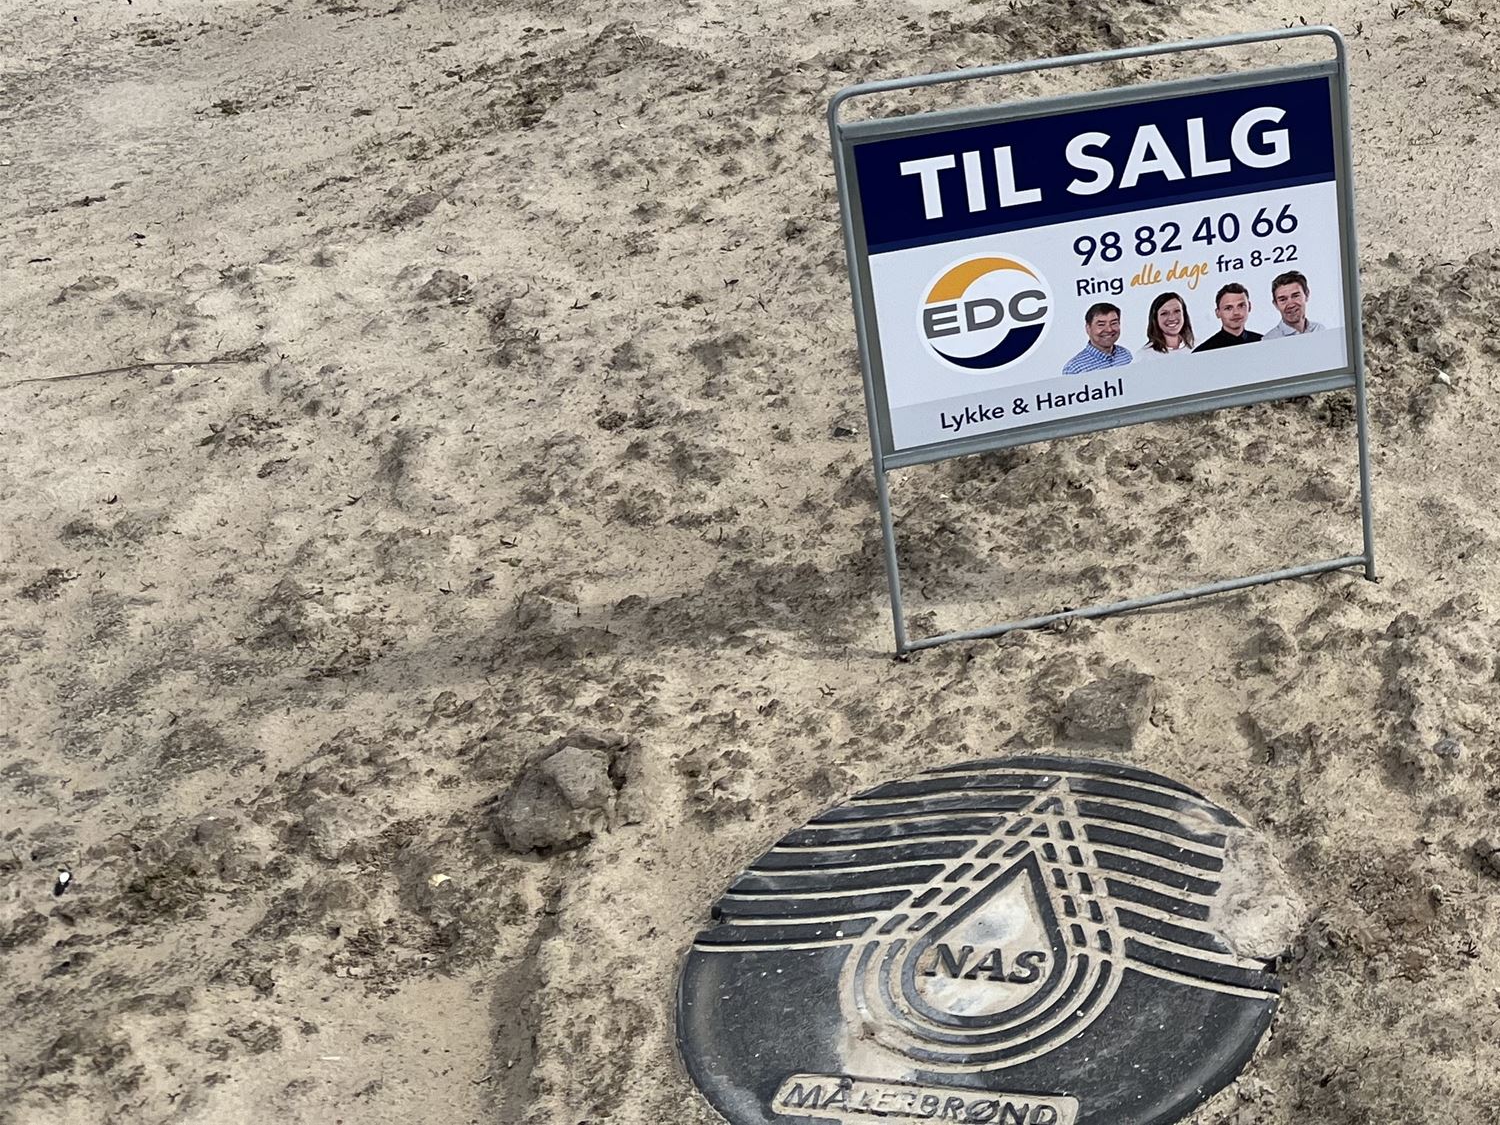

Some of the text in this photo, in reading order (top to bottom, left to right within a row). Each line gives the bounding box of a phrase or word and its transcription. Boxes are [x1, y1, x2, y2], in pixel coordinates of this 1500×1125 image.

[900, 106, 1291, 220] TIL SALG
[1073, 204, 1298, 266] 98 82 40 66
[1076, 244, 1298, 296] Ring alle dage fra 8-22
[923, 289, 1048, 339] EDC
[940, 379, 1124, 432] Lykke & Hardahl
[924, 943, 1046, 984] NAS
